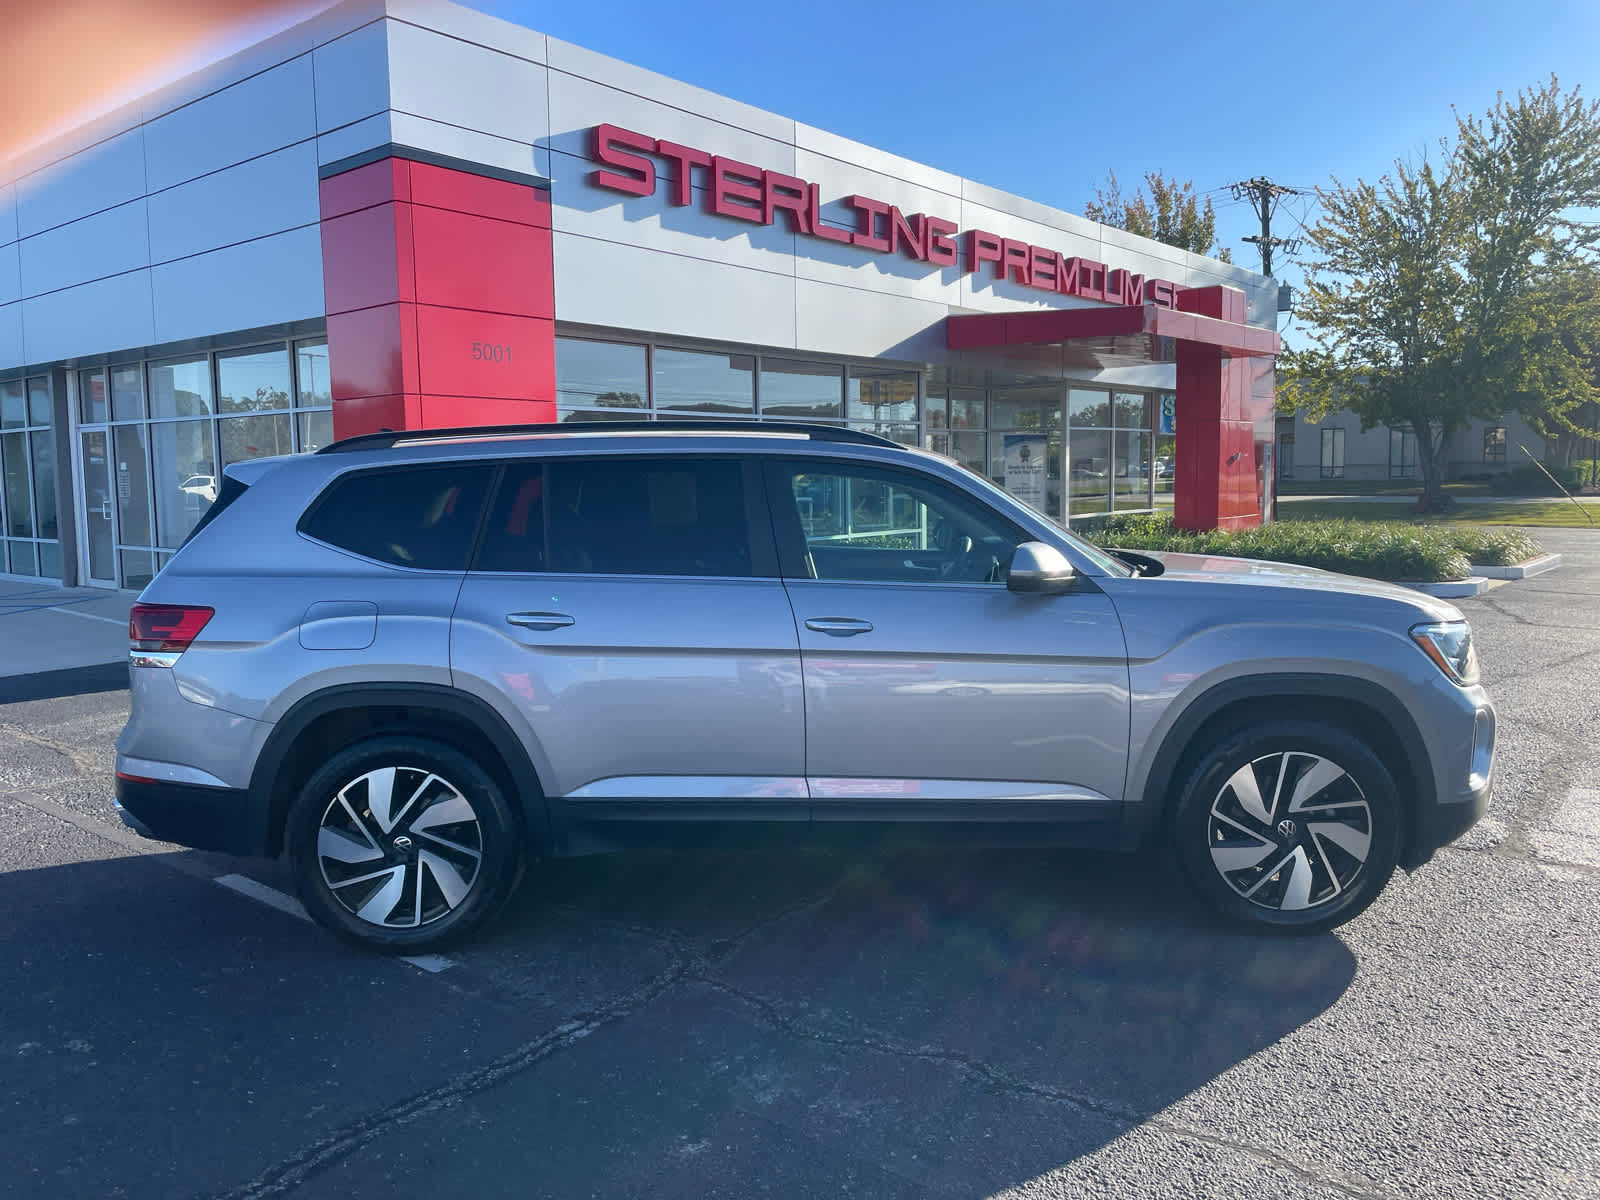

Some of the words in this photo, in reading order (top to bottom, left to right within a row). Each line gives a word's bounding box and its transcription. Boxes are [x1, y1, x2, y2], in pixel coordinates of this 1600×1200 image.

[590, 123, 958, 268] STERLING
[967, 229, 1145, 306] PREMIUM
[471, 342, 512, 364] 5001
